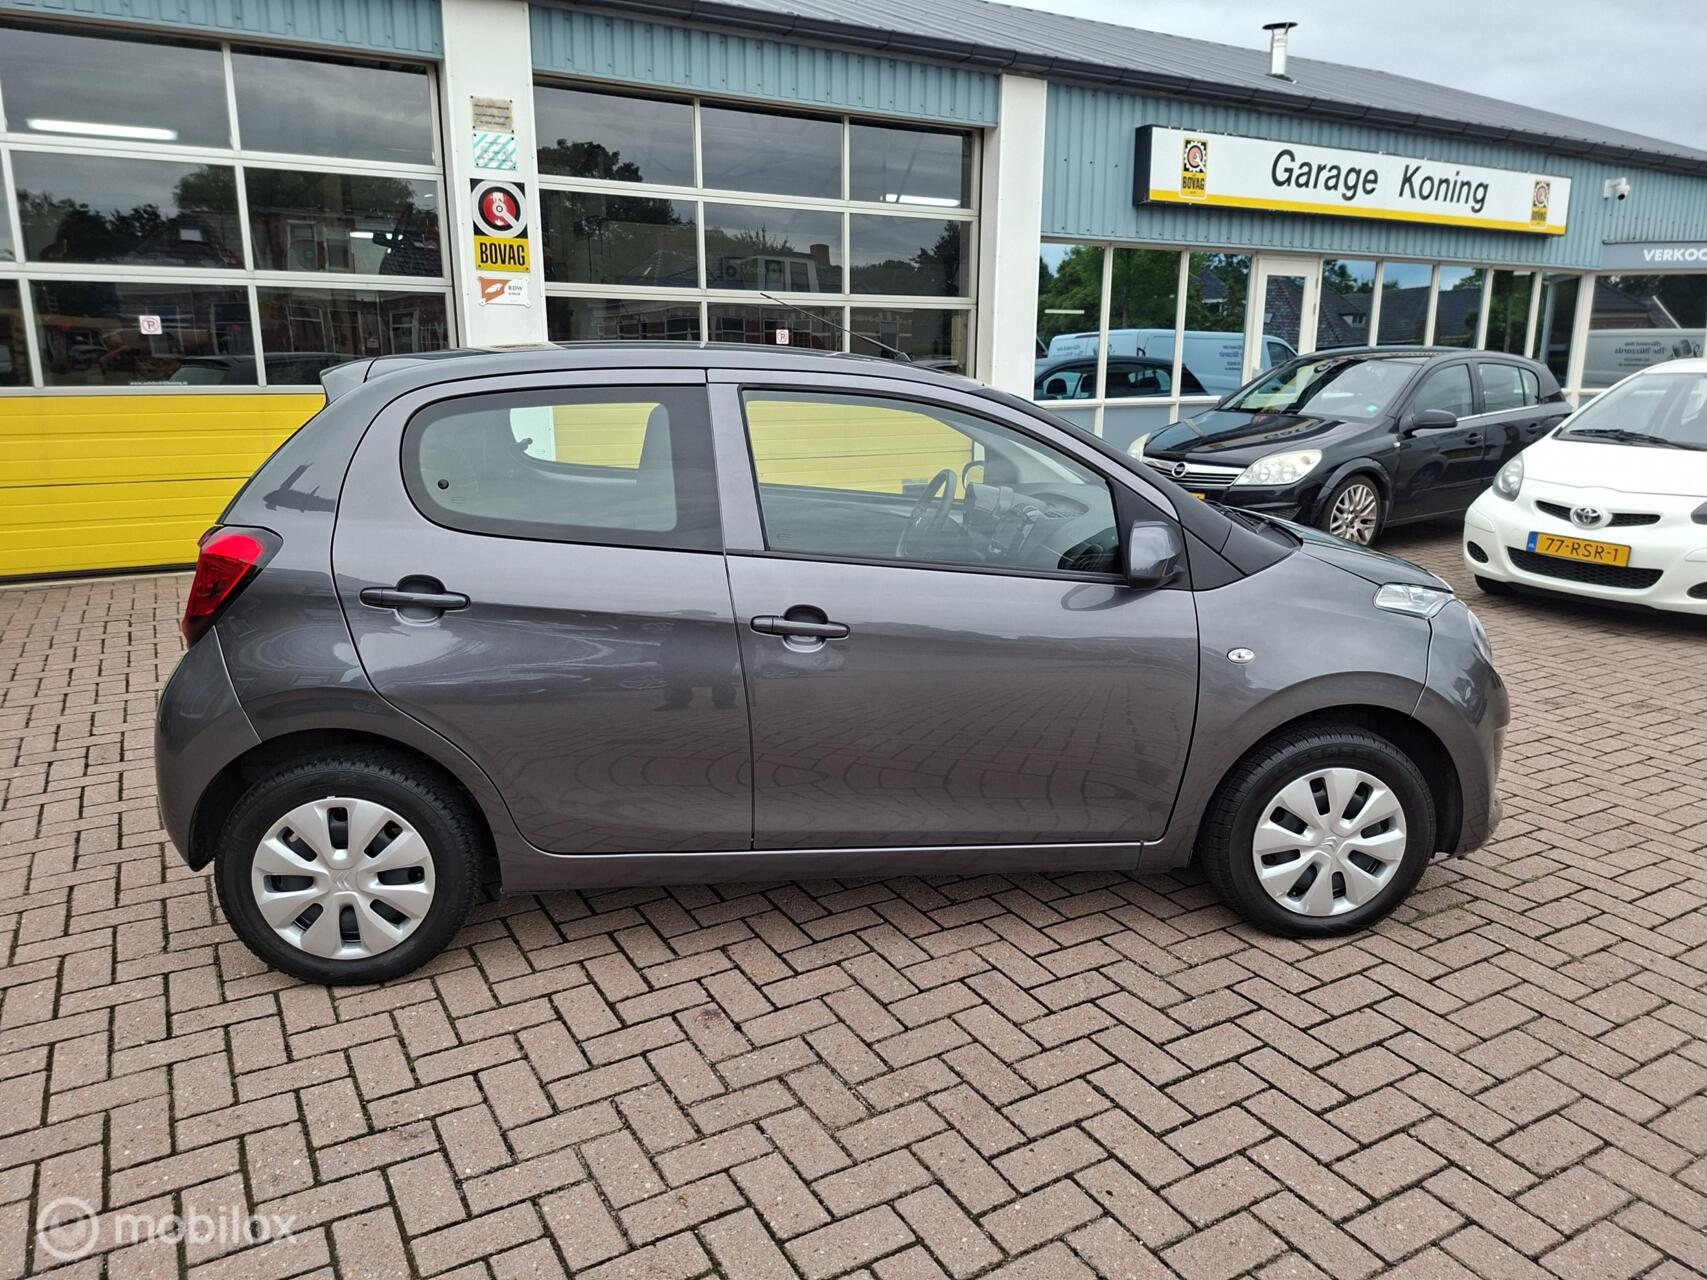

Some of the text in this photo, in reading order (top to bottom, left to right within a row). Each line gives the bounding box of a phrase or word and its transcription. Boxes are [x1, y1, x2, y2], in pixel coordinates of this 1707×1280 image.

[1182, 176, 1205, 190] BOVAG
[1271, 149, 1489, 213] Garage Koning
[479, 242, 526, 266] BOVAG
[1544, 537, 1619, 562] 77-RSR-1
